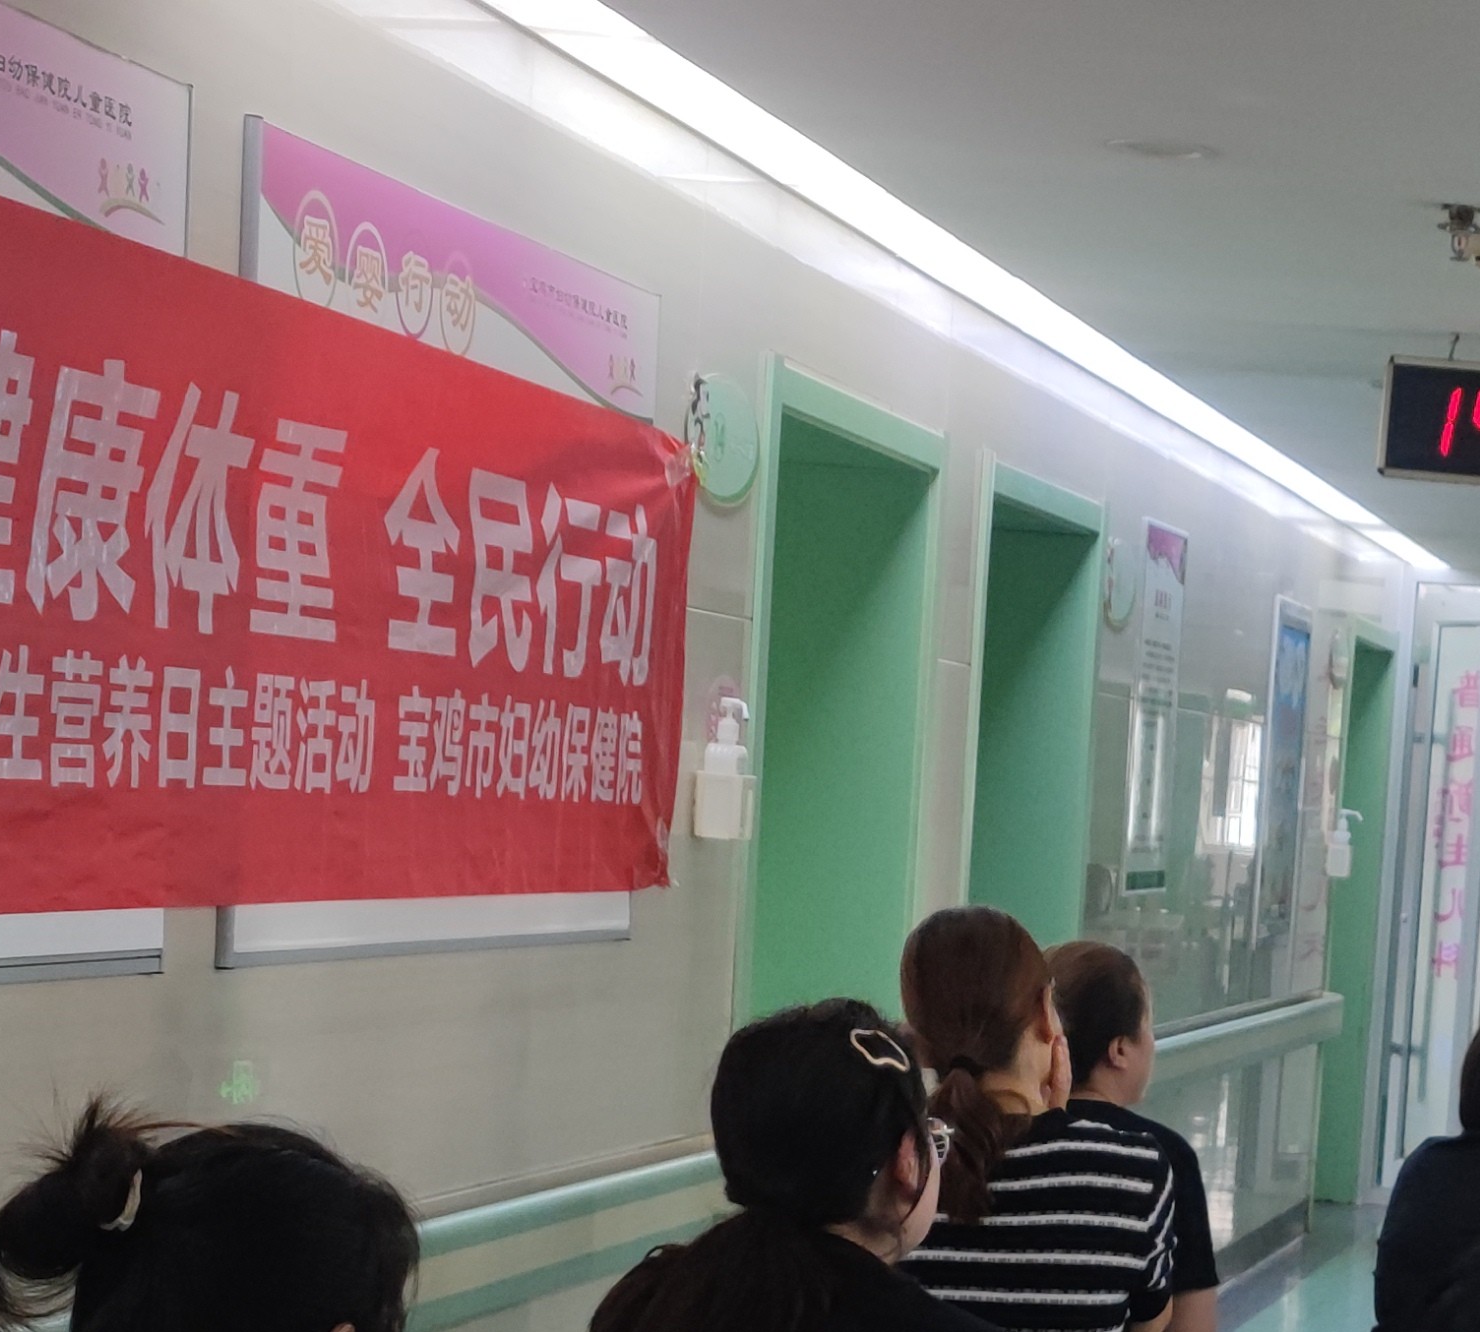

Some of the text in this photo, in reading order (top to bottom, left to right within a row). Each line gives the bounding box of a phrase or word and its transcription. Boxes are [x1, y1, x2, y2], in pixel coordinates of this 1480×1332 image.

[297, 214, 475, 332] 爱婴行动
[384, 448, 657, 687] 全民行动
[393, 686, 642, 804] 宝鸡市妇幼保健院
